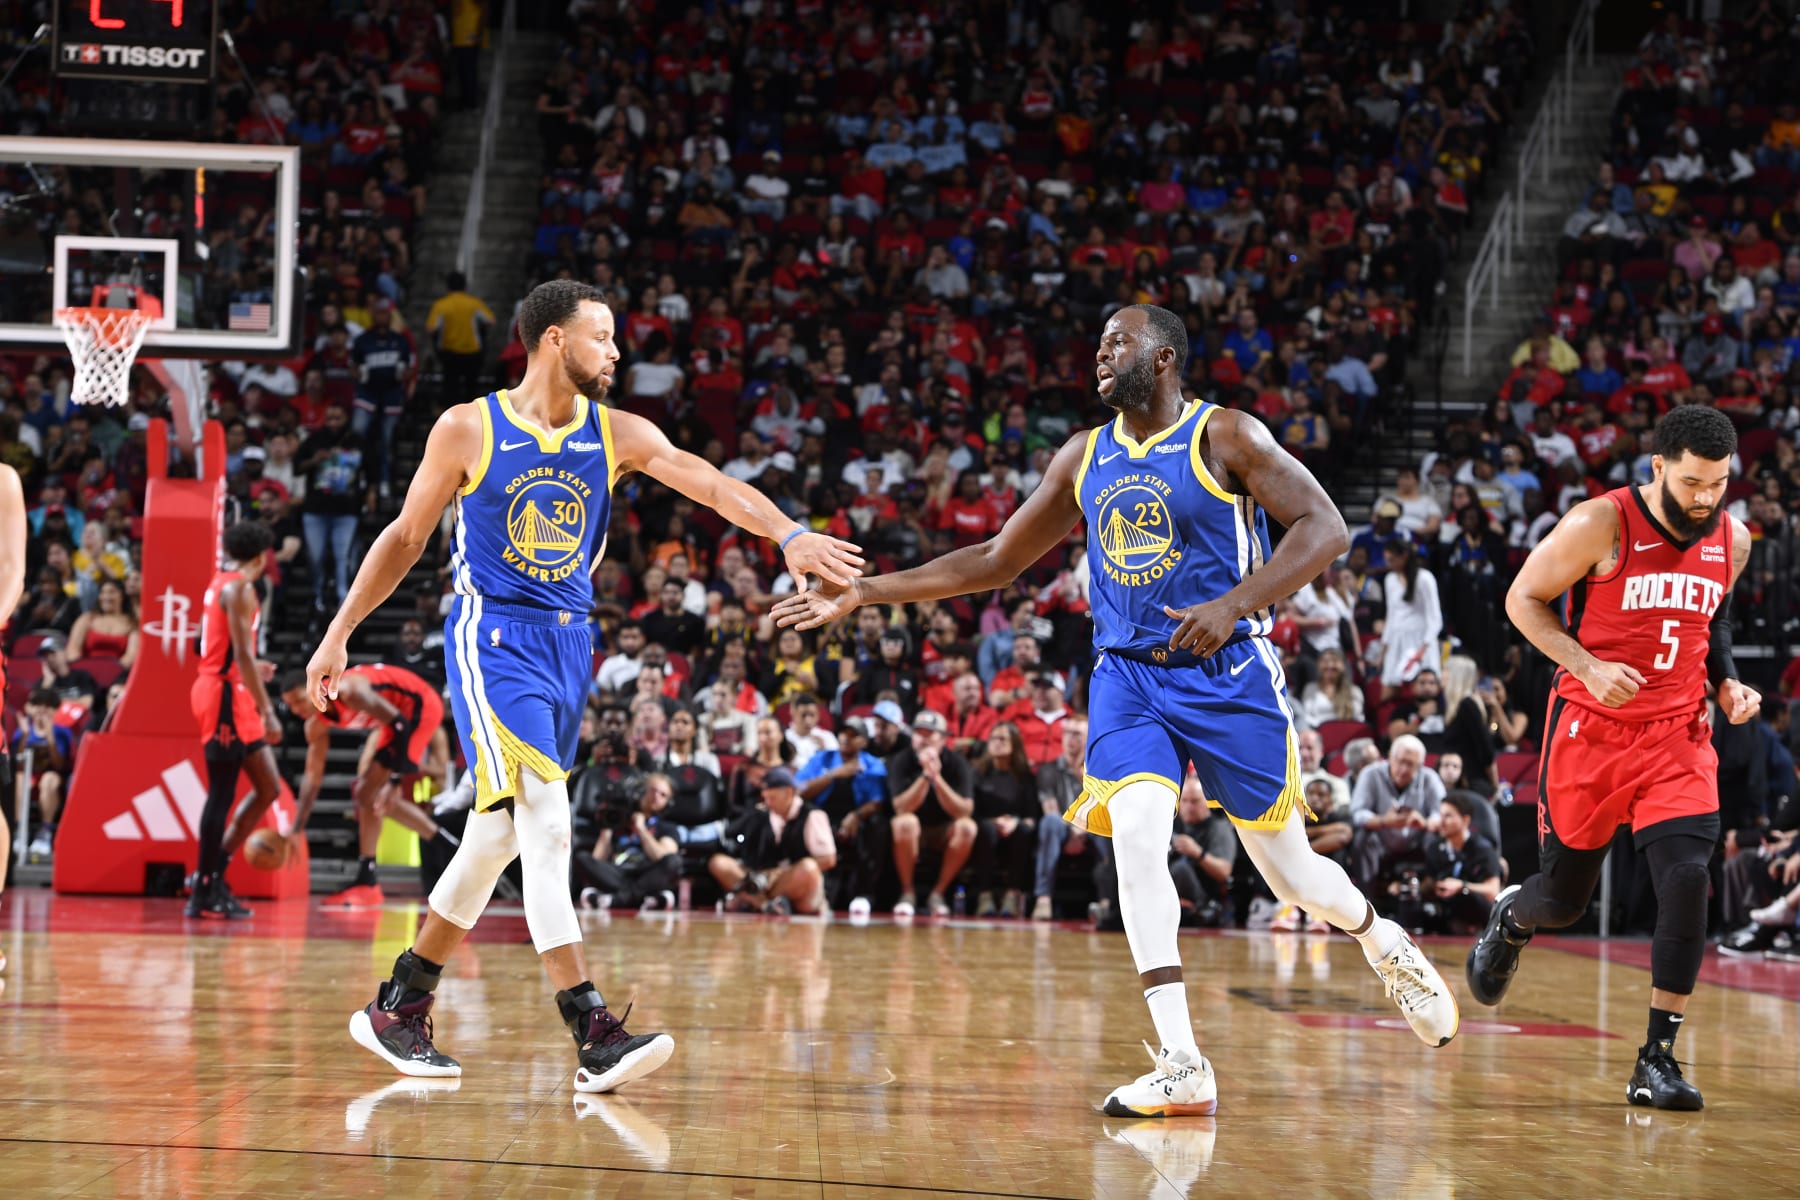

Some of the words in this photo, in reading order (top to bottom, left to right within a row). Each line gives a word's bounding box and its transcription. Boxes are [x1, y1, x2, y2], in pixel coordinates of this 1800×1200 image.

[101, 45, 205, 68] TISSOT
[567, 440, 601, 452] Rakuten
[1155, 443, 1188, 454] Rakuten
[505, 467, 554, 494] GOLDEN
[558, 470, 592, 498] STATE
[1094, 474, 1140, 505] GOLDEN
[1143, 474, 1172, 497] STATE
[551, 501, 580, 526] 30
[1134, 501, 1162, 527] 23
[1700, 552, 1725, 562] karma
[1701, 545, 1725, 554] credit
[1102, 548, 1182, 587] WARRIORS
[1621, 572, 1724, 617] ROCKETS
[1653, 619, 1681, 670] 5
